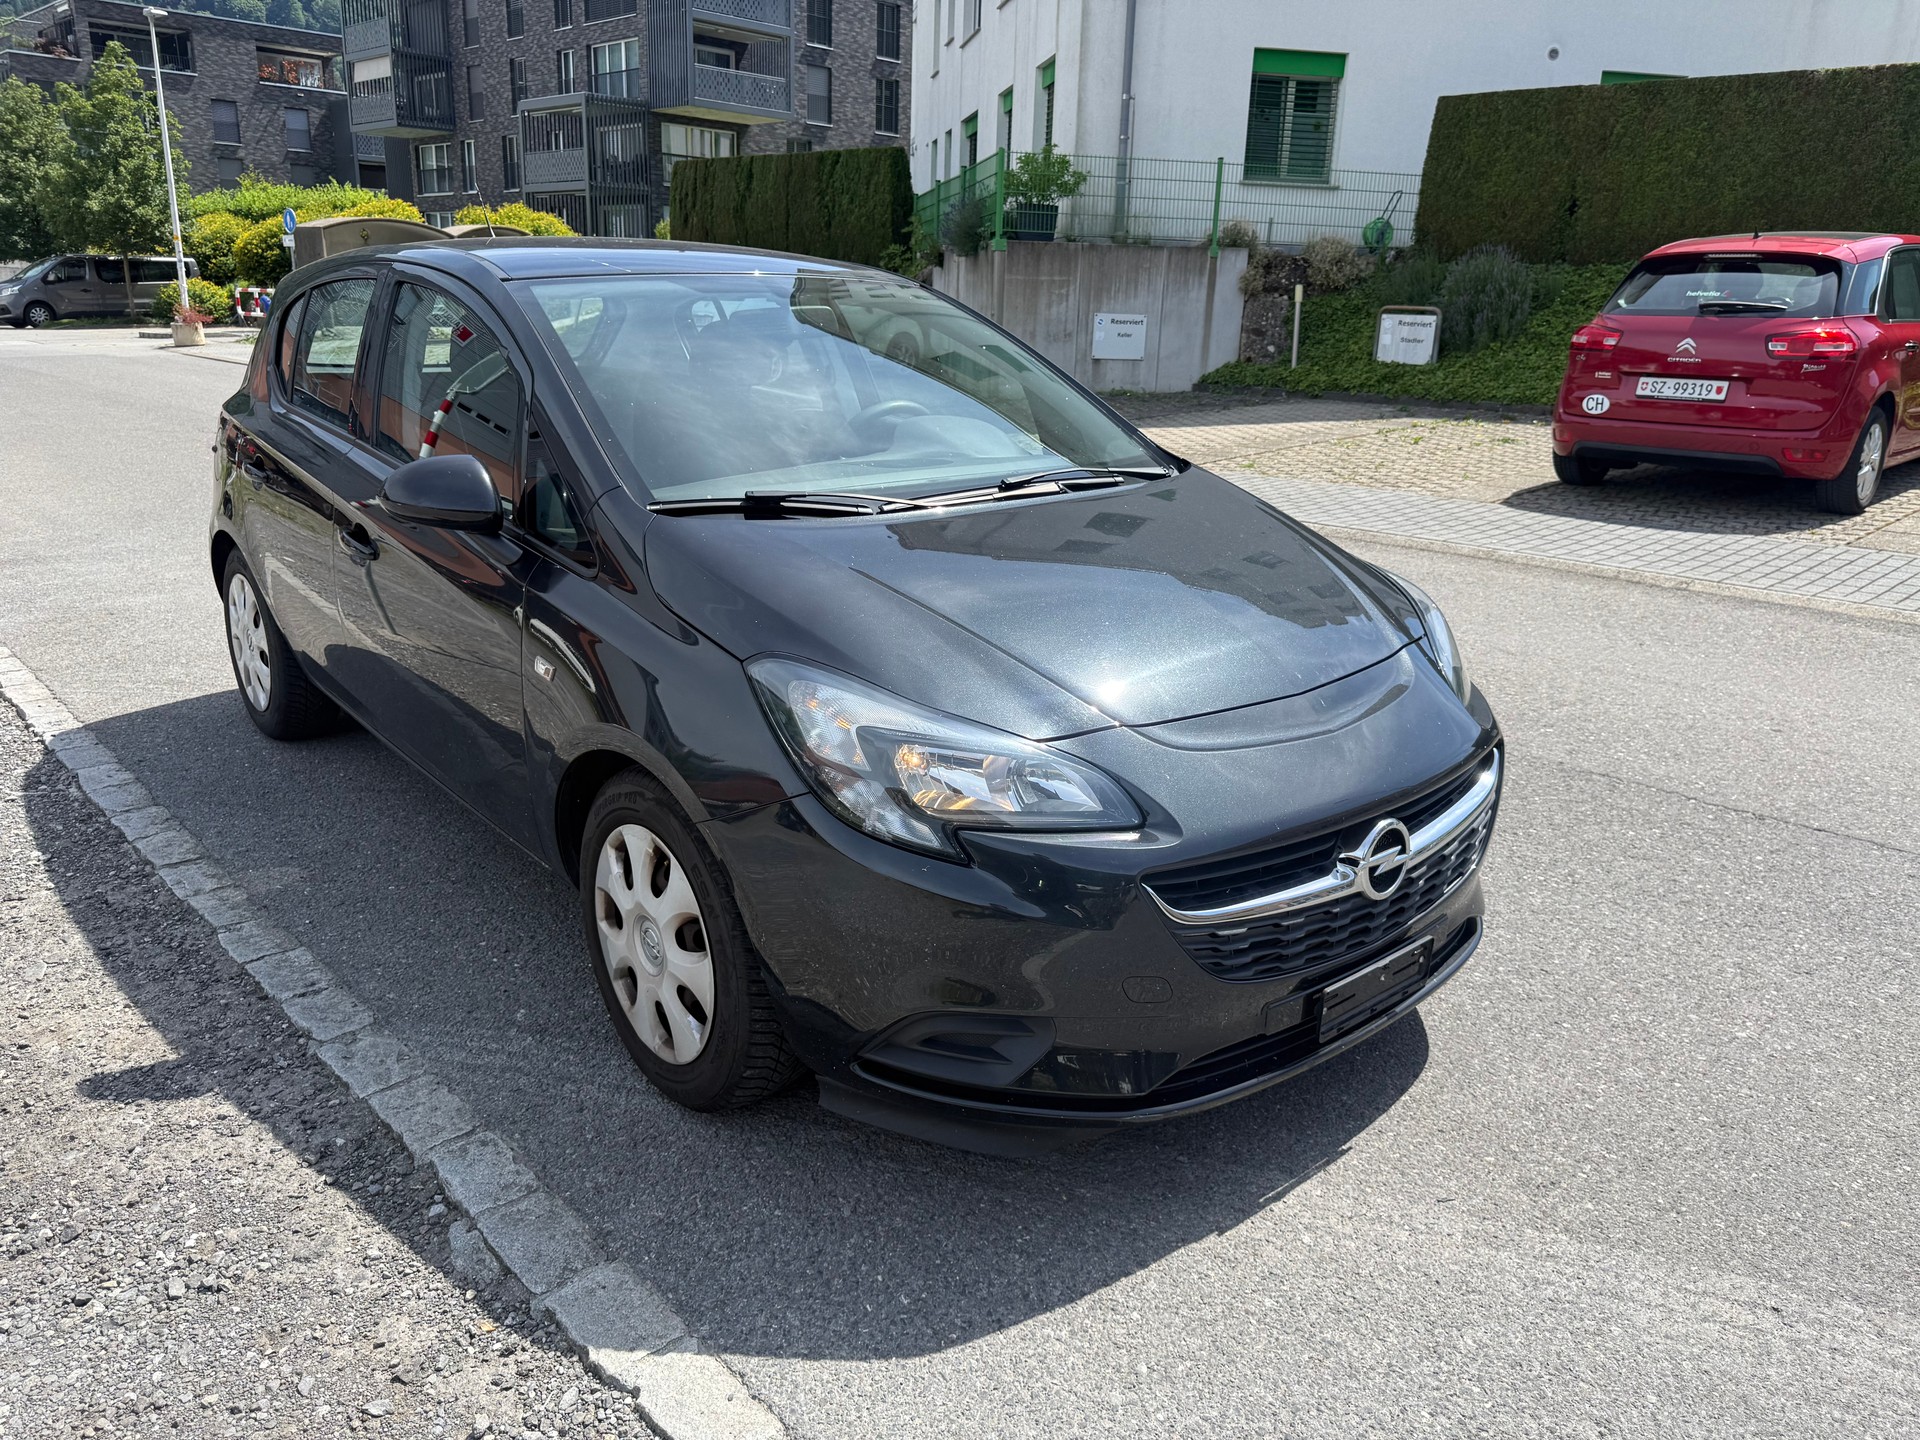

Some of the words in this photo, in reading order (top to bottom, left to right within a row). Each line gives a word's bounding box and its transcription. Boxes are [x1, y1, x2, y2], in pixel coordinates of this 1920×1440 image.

[1110, 318, 1144, 326] Reserviert
[1398, 320, 1432, 328] Reserviert
[1586, 396, 1604, 411] CH
